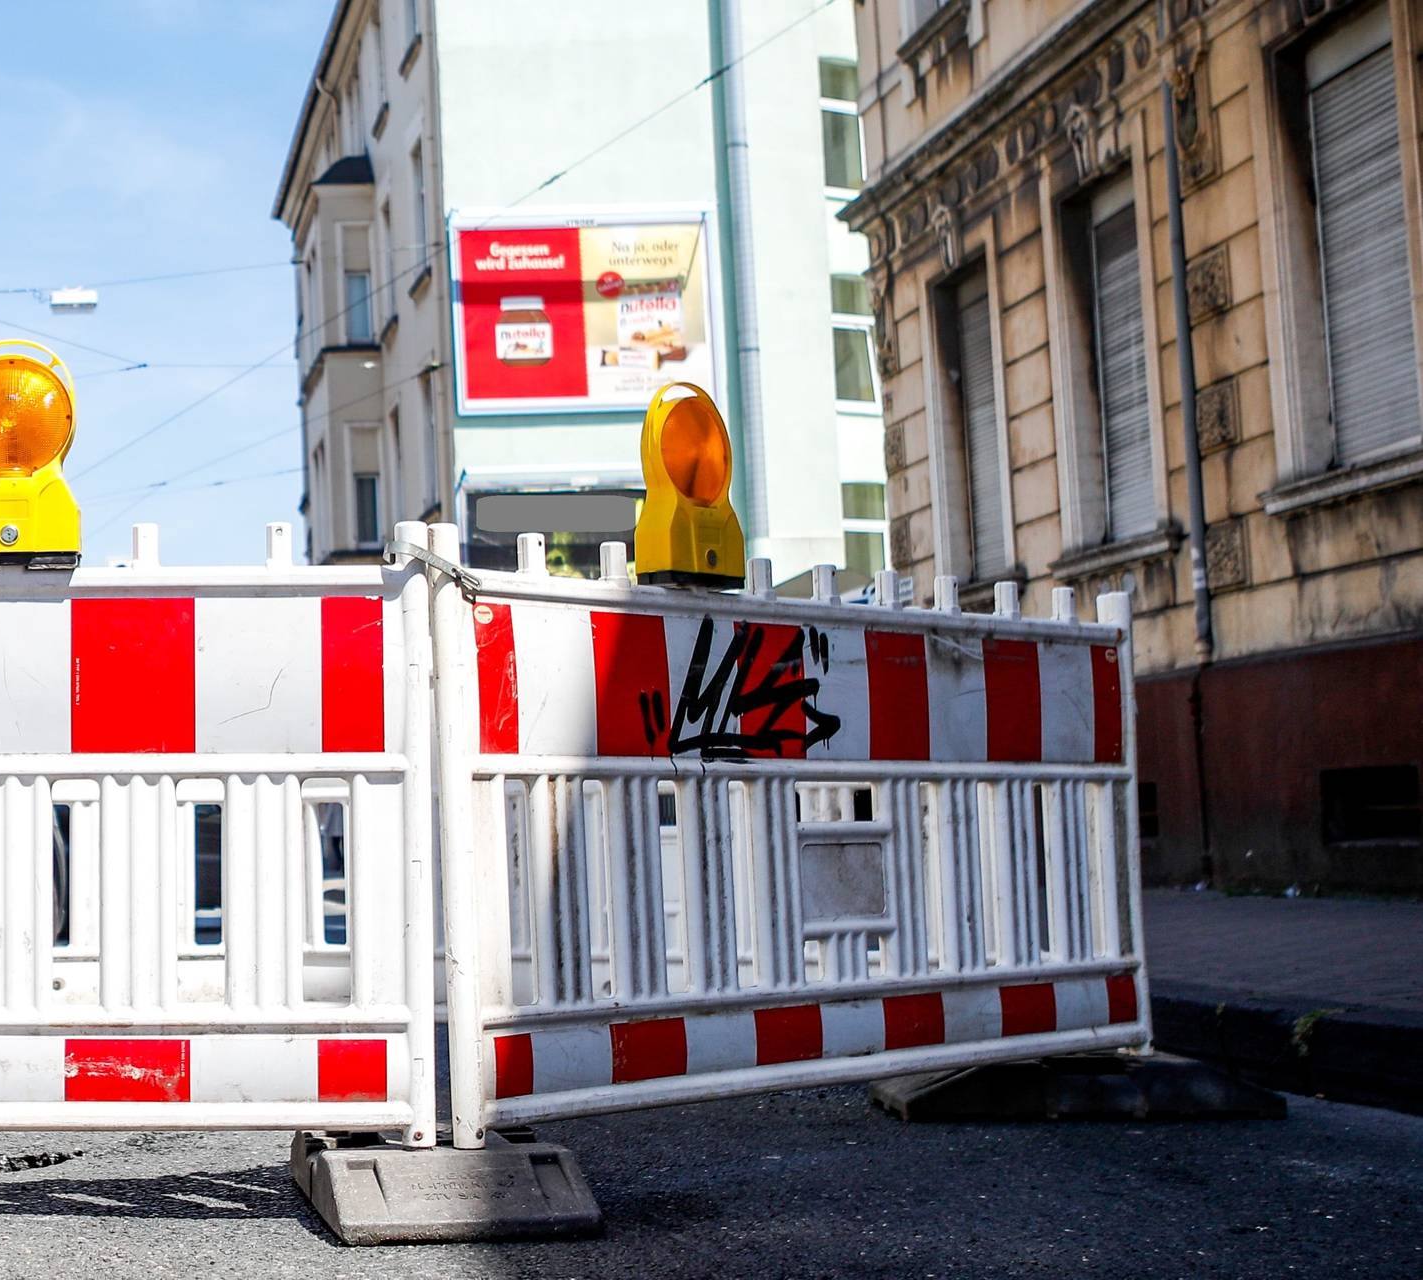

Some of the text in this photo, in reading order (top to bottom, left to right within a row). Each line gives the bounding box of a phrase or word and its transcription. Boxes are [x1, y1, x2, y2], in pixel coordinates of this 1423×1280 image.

[489, 242, 550, 259] Gegessen
[475, 254, 565, 271] wird zuhause!
